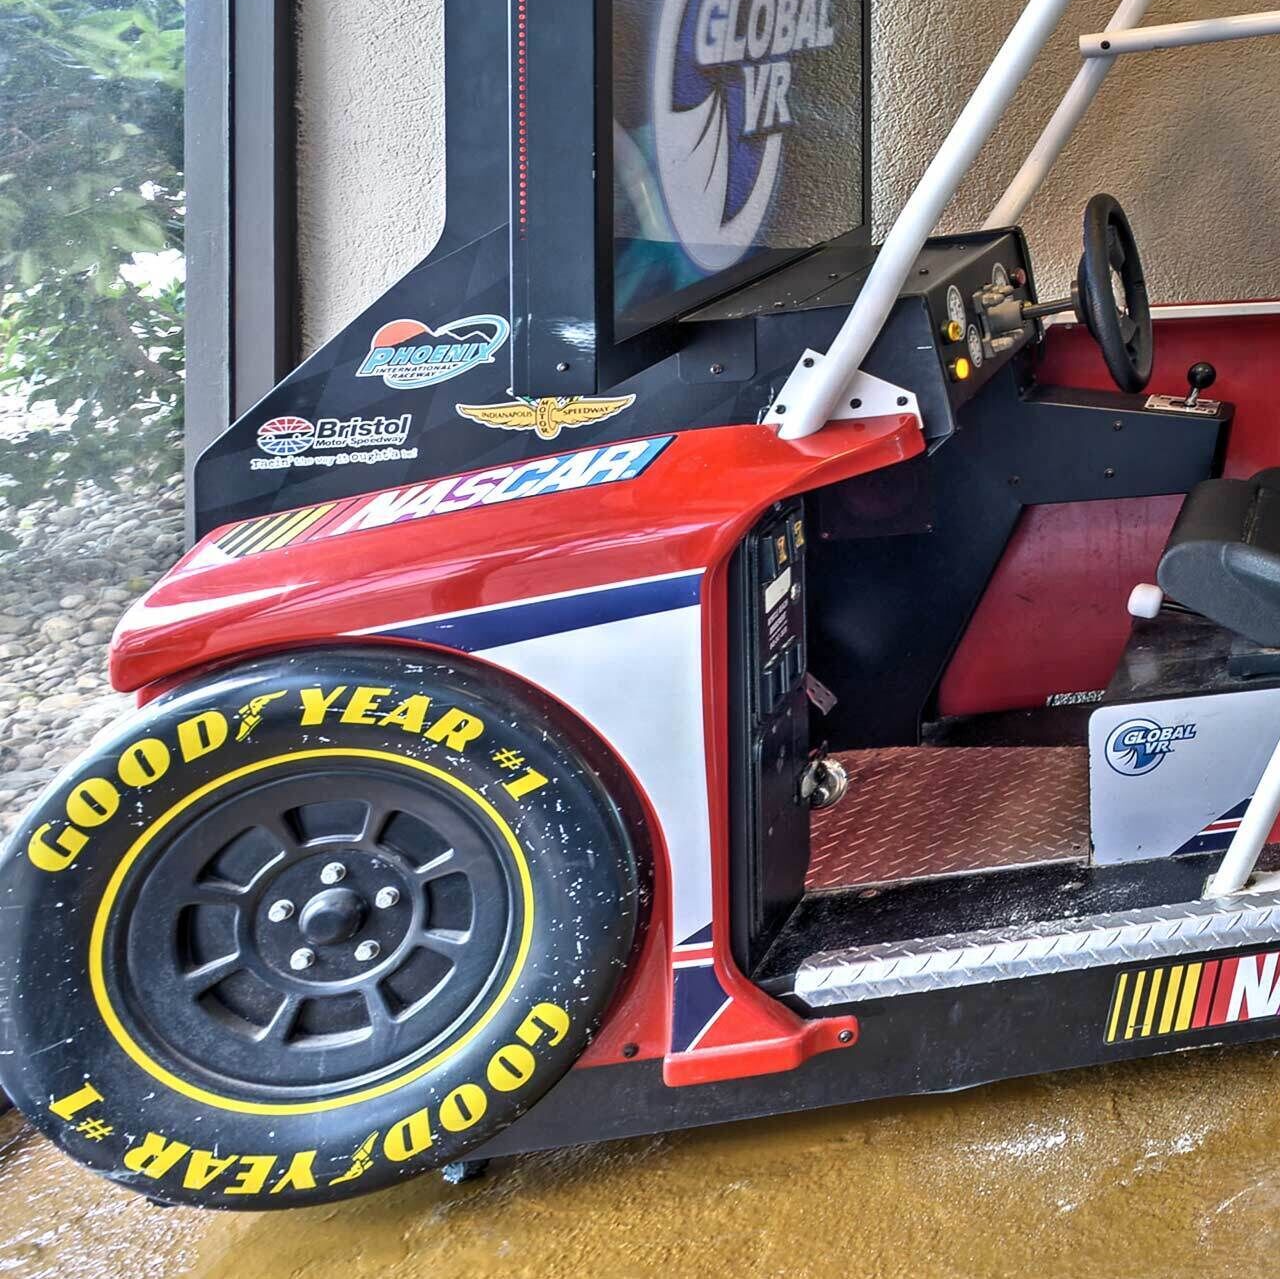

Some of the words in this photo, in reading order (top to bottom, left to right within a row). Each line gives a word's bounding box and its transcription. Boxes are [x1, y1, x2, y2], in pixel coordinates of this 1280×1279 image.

[741, 60, 794, 134] VR
[360, 342, 492, 375] PHOENIX
[376, 363, 453, 374] INTERNATIONAL
[391, 371, 437, 379] RACEWAY
[481, 410, 533, 419] INDIANAPOLIS
[540, 400, 550, 434] MOTOR
[562, 405, 610, 416] SPEEDWAY
[317, 415, 409, 439] Bristol
[315, 438, 347, 448] Motor
[350, 436, 405, 447] Speedway
[338, 439, 650, 534] NASCAR
[1123, 724, 1197, 745] GLOBAL
[1144, 740, 1170, 754] VR
[27, 709, 228, 872] GOOD
[299, 685, 486, 753] YEAR
[491, 745, 549, 803] #1
[383, 1001, 571, 1163] GOOD
[50, 1081, 115, 1141] #1
[124, 1130, 318, 1196] YEAR
